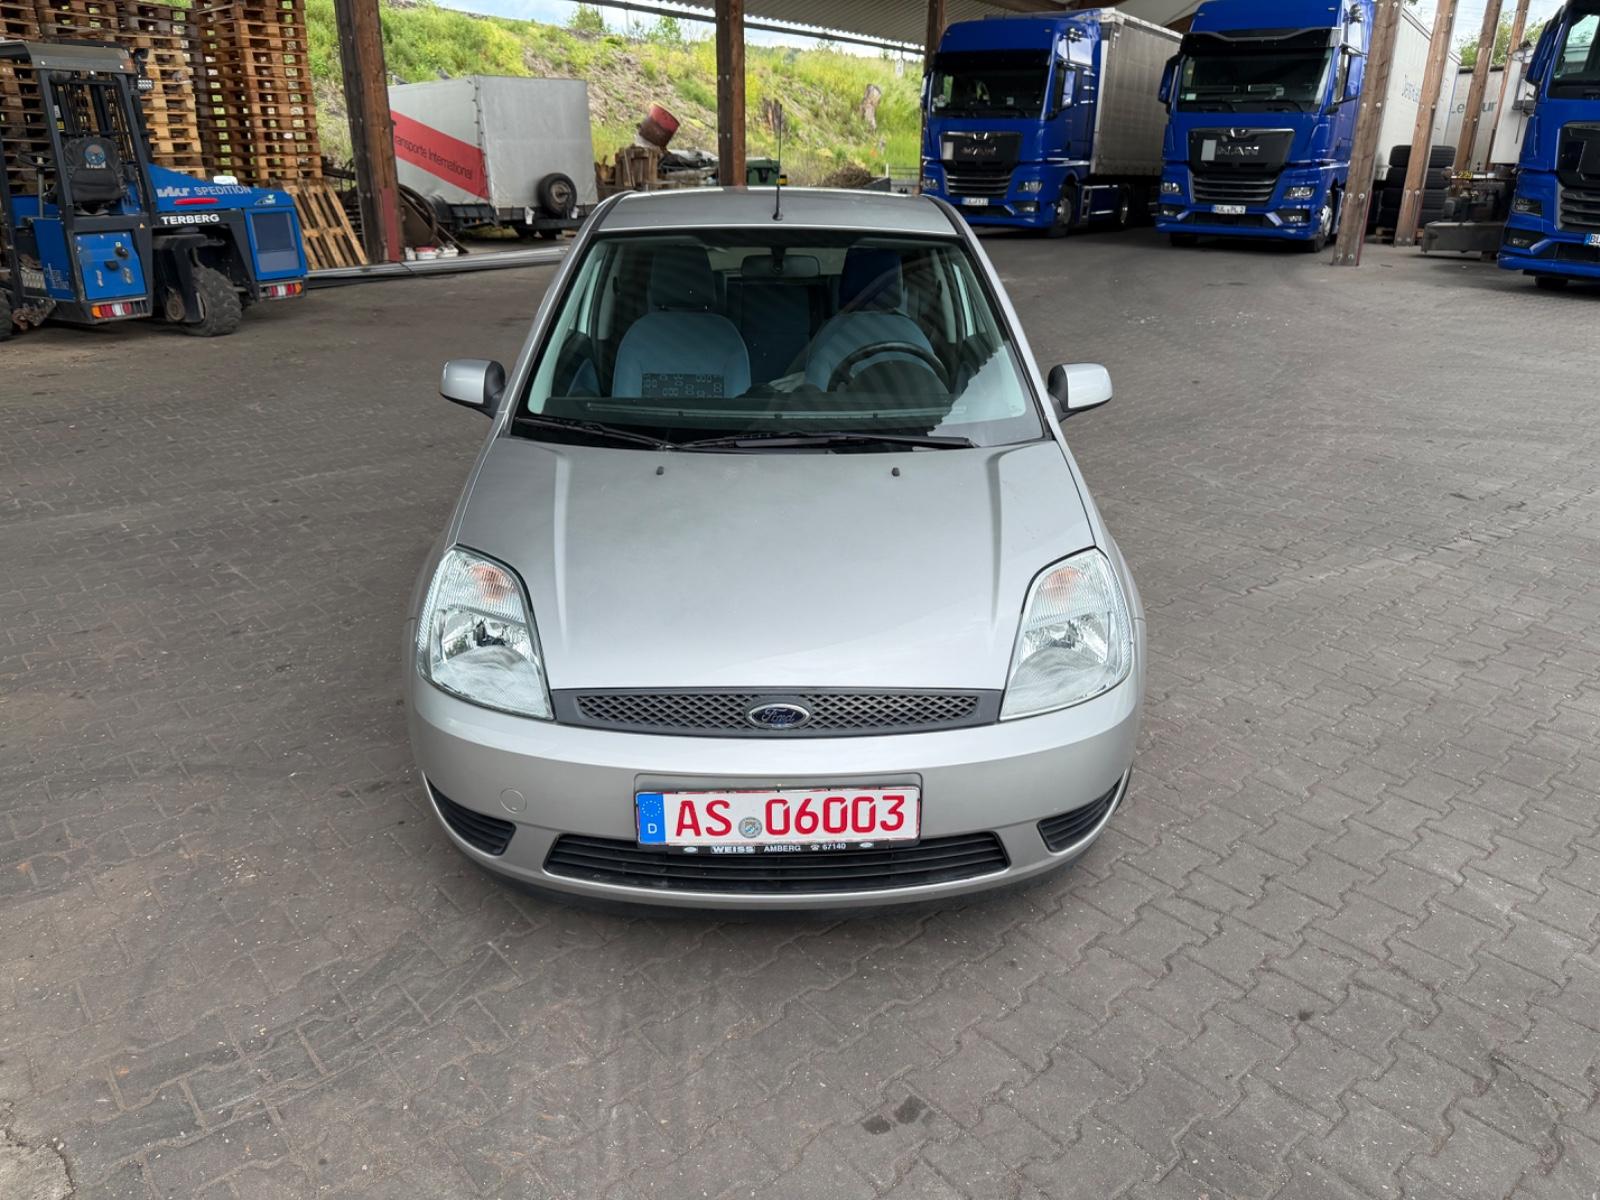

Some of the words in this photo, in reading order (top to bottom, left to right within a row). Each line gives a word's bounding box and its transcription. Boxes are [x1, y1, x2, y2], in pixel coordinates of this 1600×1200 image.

[395, 135, 428, 159] ransporte
[428, 147, 473, 180] International
[194, 184, 252, 196] SPEDITION
[160, 213, 220, 225] TERBERG
[762, 708, 796, 722] Ford
[675, 799, 732, 837] AS
[765, 795, 905, 836] 06003
[647, 823, 658, 834] D
[711, 846, 755, 854] WEISS
[763, 844, 801, 853] AMBERG
